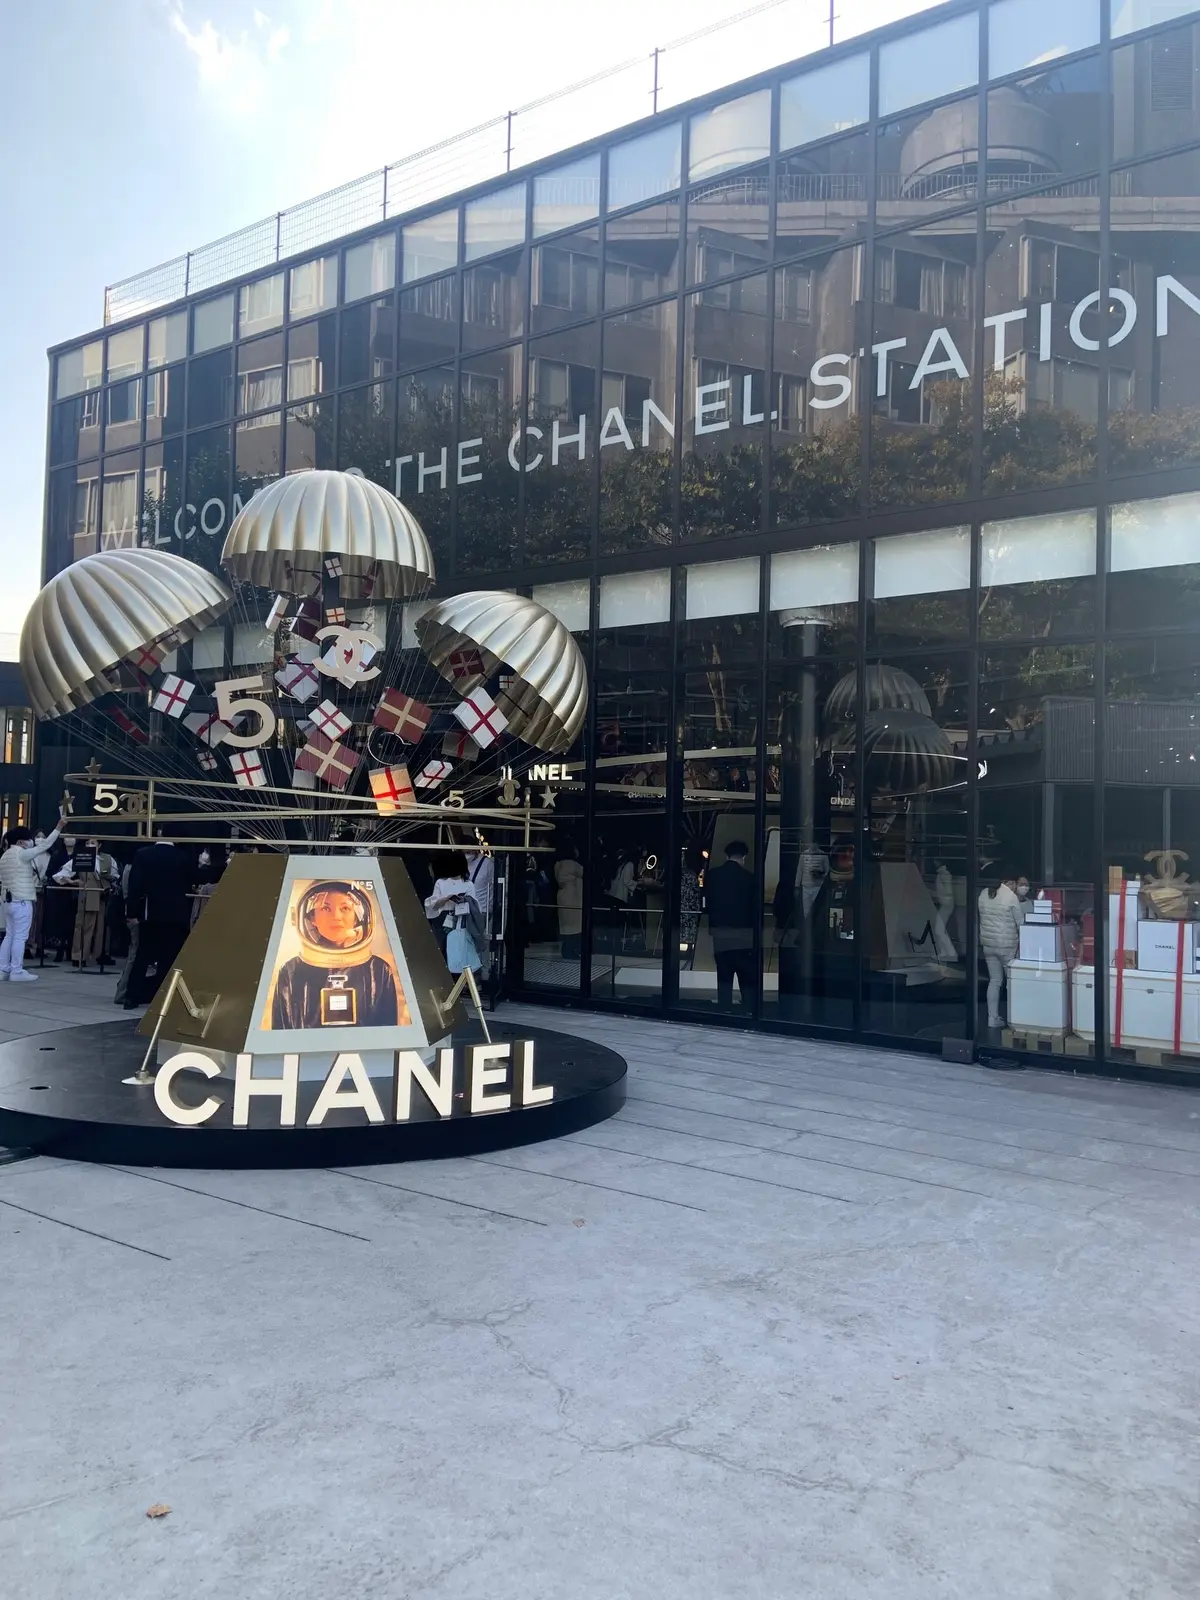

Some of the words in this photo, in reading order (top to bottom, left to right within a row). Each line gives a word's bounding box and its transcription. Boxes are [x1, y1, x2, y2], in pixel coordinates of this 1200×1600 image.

[386, 437, 482, 498] THE
[507, 374, 778, 473] CHANEL
[808, 274, 1200, 410] STATION
[215, 675, 275, 748] 5
[93, 783, 118, 813] 5
[153, 1039, 554, 1128] CHANEL
